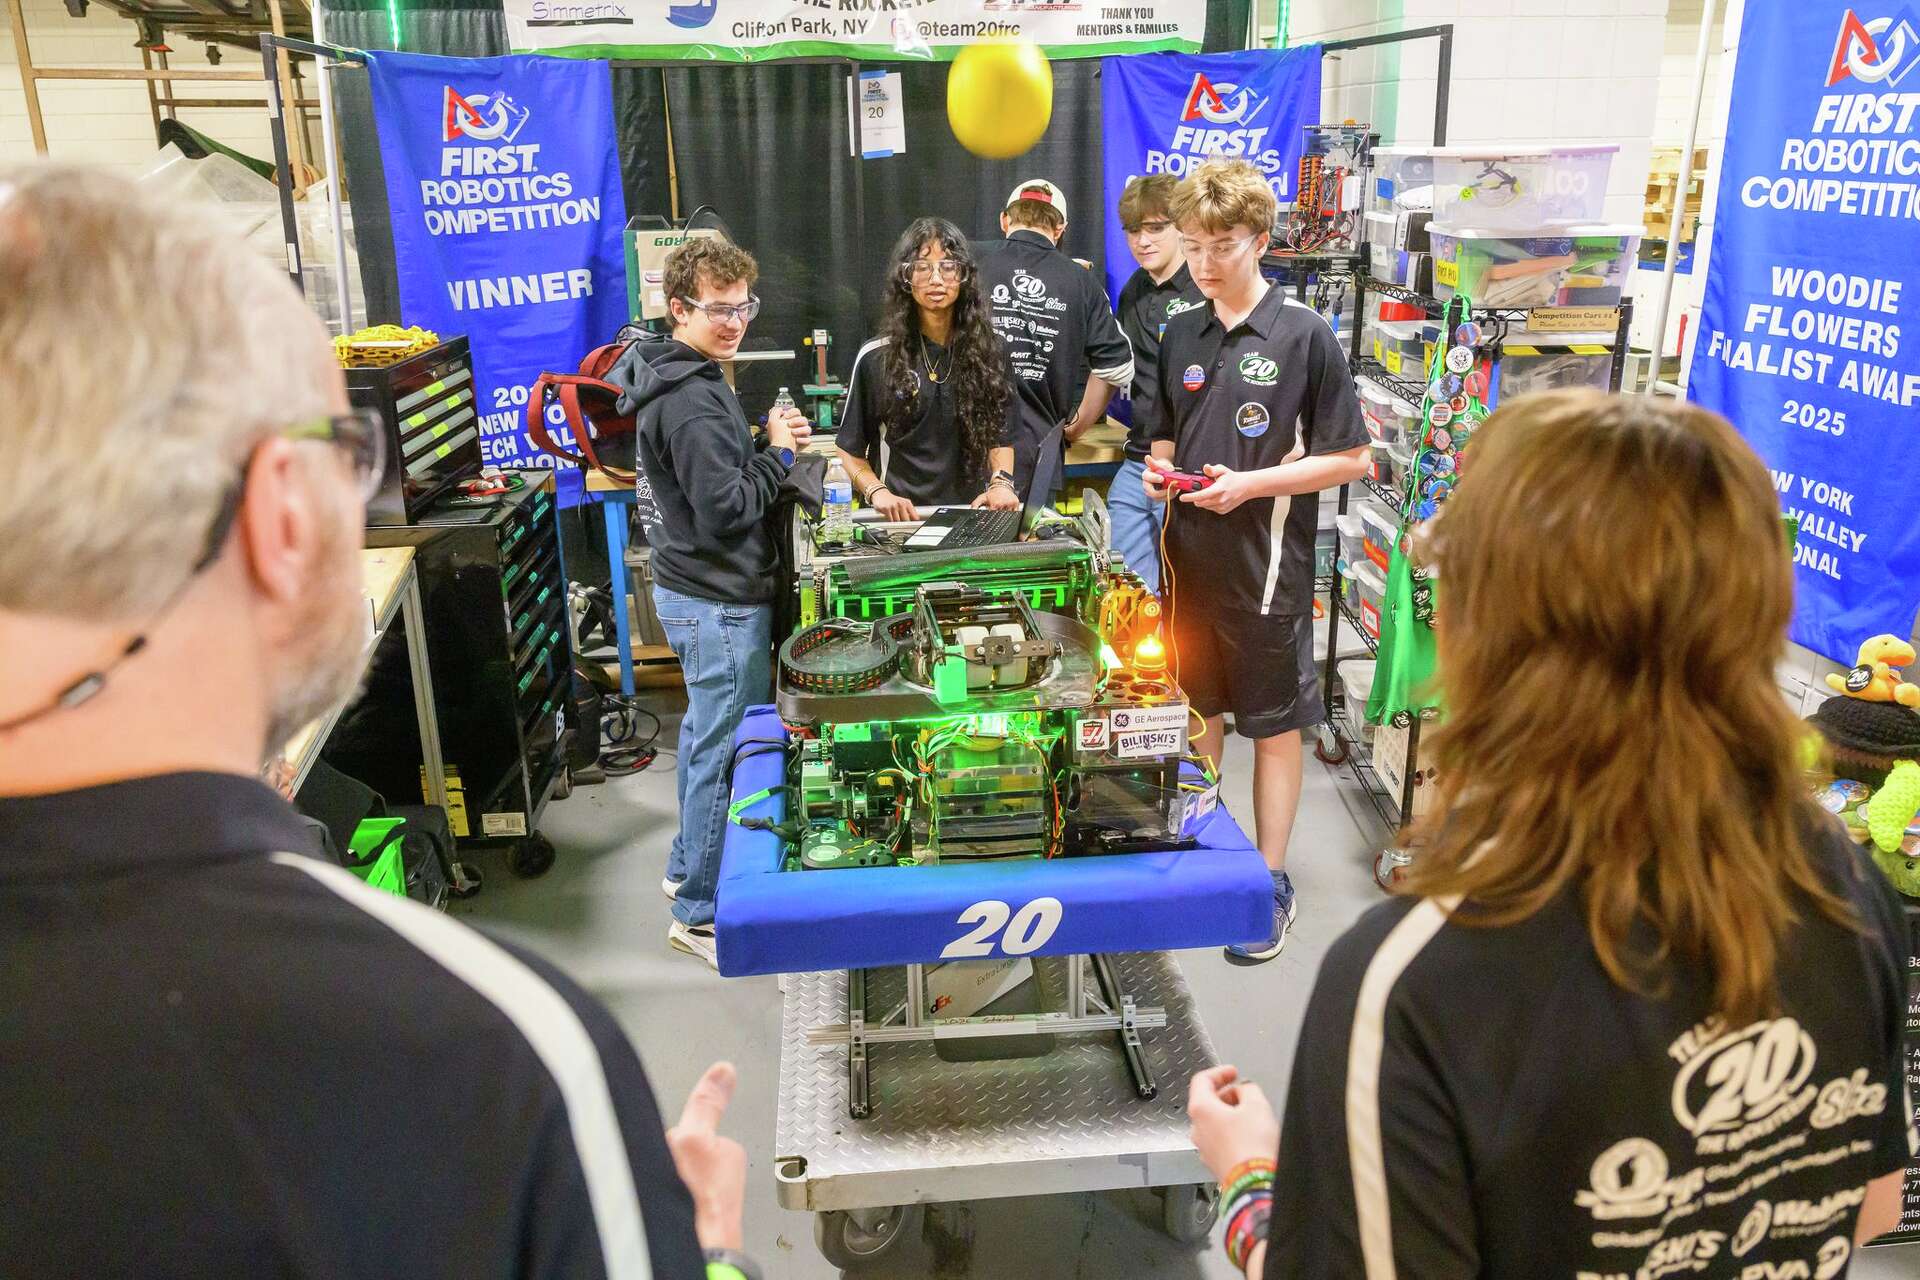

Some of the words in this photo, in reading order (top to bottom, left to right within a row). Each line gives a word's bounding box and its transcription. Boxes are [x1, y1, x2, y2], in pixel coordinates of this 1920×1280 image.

[732, 18, 786, 38] Clifton
[791, 17, 837, 37] Park,
[843, 19, 868, 35] NY
[917, 21, 1021, 40] @team20frc
[1077, 24, 1123, 36] MENTORS
[1125, 24, 1133, 34] &
[1134, 23, 1179, 35] FAMILIES
[1101, 7, 1132, 20] THANK
[1134, 7, 1154, 19] YOU
[868, 106, 884, 119] 20
[1811, 92, 1920, 134] FIRST
[1171, 125, 1269, 156] FIRST
[1780, 138, 1920, 177] ROBOTIC
[441, 143, 541, 178] FIRST
[420, 172, 573, 206] ROBOTICS
[1740, 175, 1920, 221] COMPETITI
[424, 196, 602, 236] OMPETITION
[1016, 276, 1042, 295] 20
[1771, 266, 1903, 315] WOODIE
[1532, 312, 1583, 321] Competition
[1743, 303, 1901, 359] FLOWERS
[1242, 360, 1276, 377] 20
[478, 410, 519, 437] NEW
[1780, 399, 1847, 437] 2025
[480, 435, 519, 461] ECH
[1801, 477, 1855, 516] YORK
[1788, 506, 1868, 553] VALLEY
[1792, 541, 1842, 581] ONAL
[1134, 715, 1145, 724] GE
[1147, 713, 1186, 723] Aerospace
[1121, 732, 1177, 749] BILINSKI'S
[939, 896, 1063, 958] 20
[1692, 1016, 1801, 1138] 20
